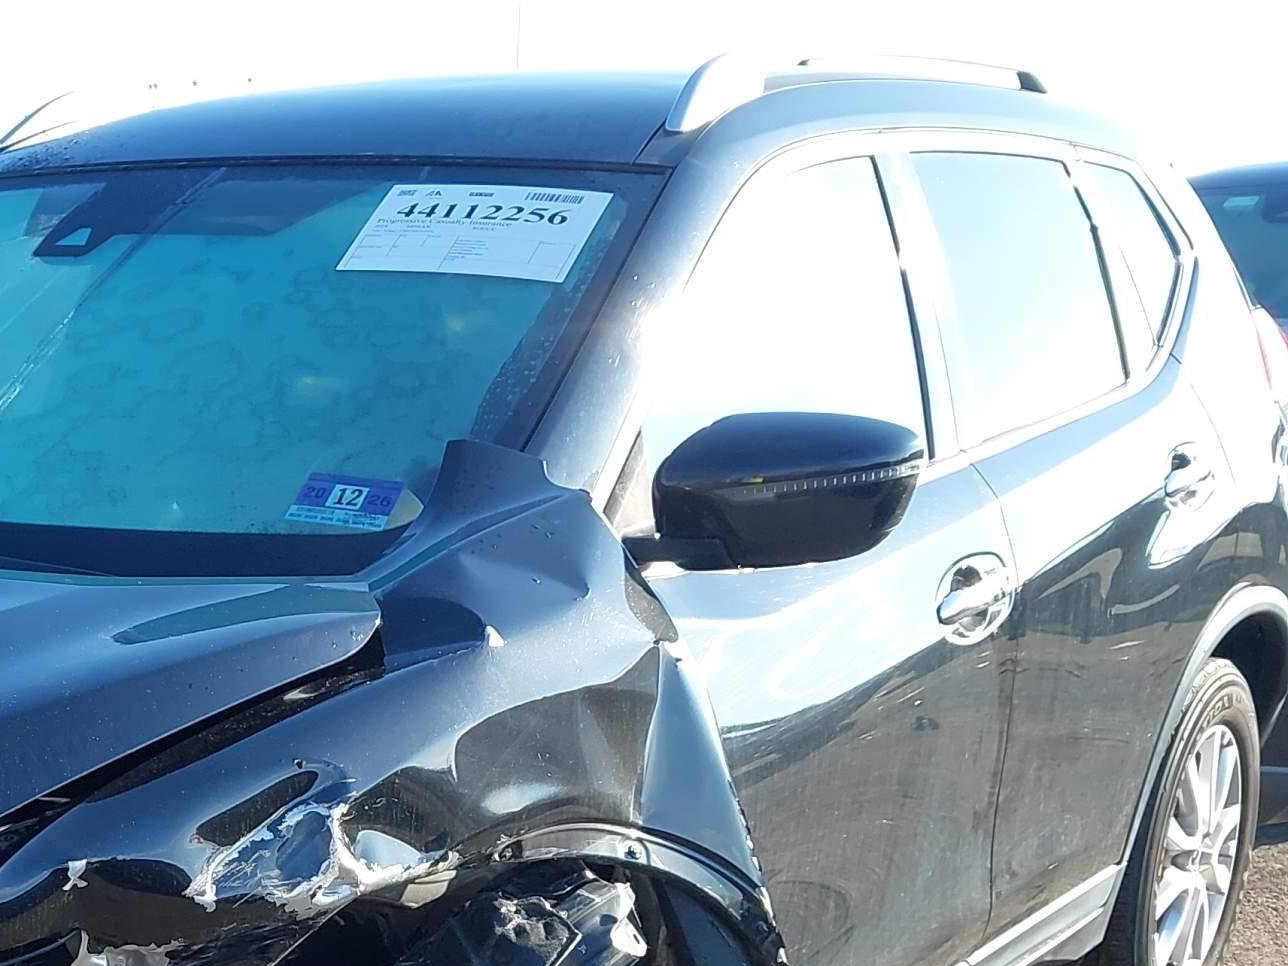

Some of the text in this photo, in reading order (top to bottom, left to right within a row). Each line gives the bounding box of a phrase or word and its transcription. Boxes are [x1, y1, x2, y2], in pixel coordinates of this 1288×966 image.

[396, 202, 572, 225] 44112256
[303, 486, 327, 499] 20
[333, 487, 363, 507] 12
